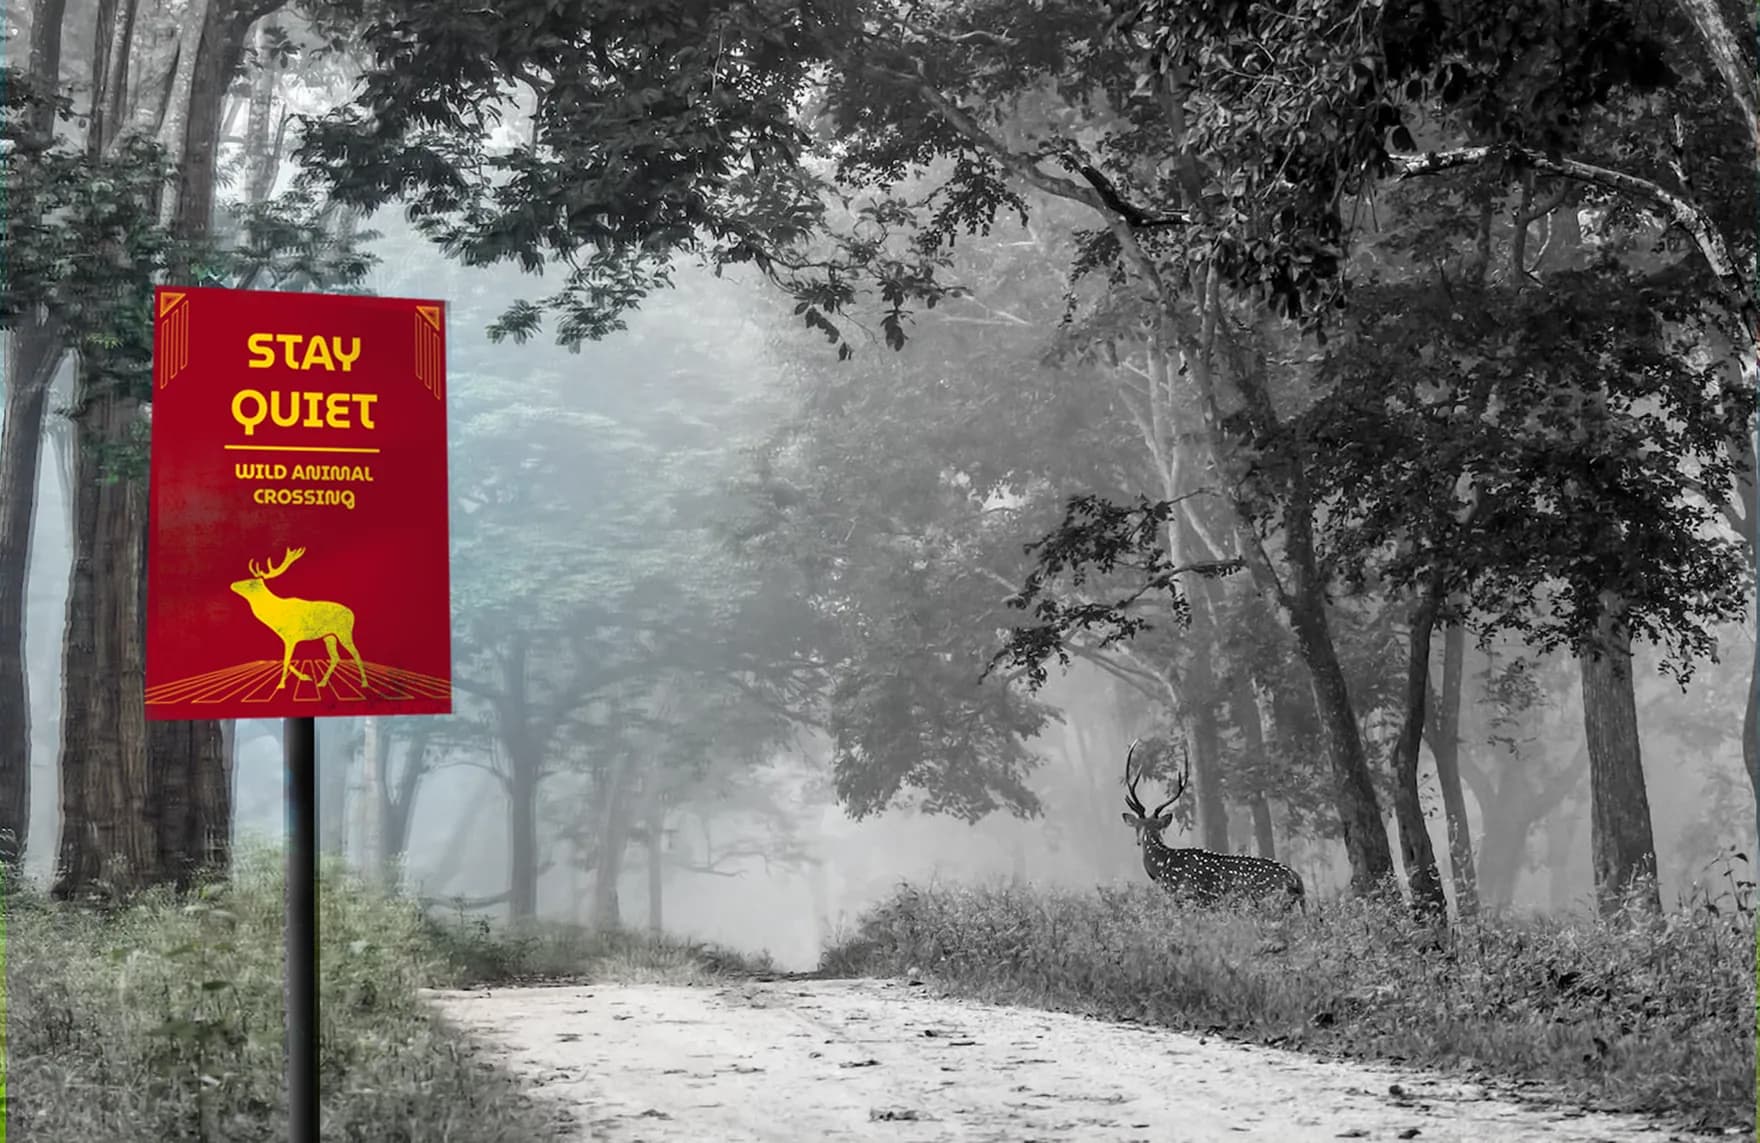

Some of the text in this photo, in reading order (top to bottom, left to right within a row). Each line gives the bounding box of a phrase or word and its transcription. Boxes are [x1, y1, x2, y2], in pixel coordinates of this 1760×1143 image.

[247, 332, 361, 371] STAY
[231, 388, 378, 436] QUIET
[235, 463, 374, 481] WILD ANIMAL
[253, 488, 356, 510] CROSSING
